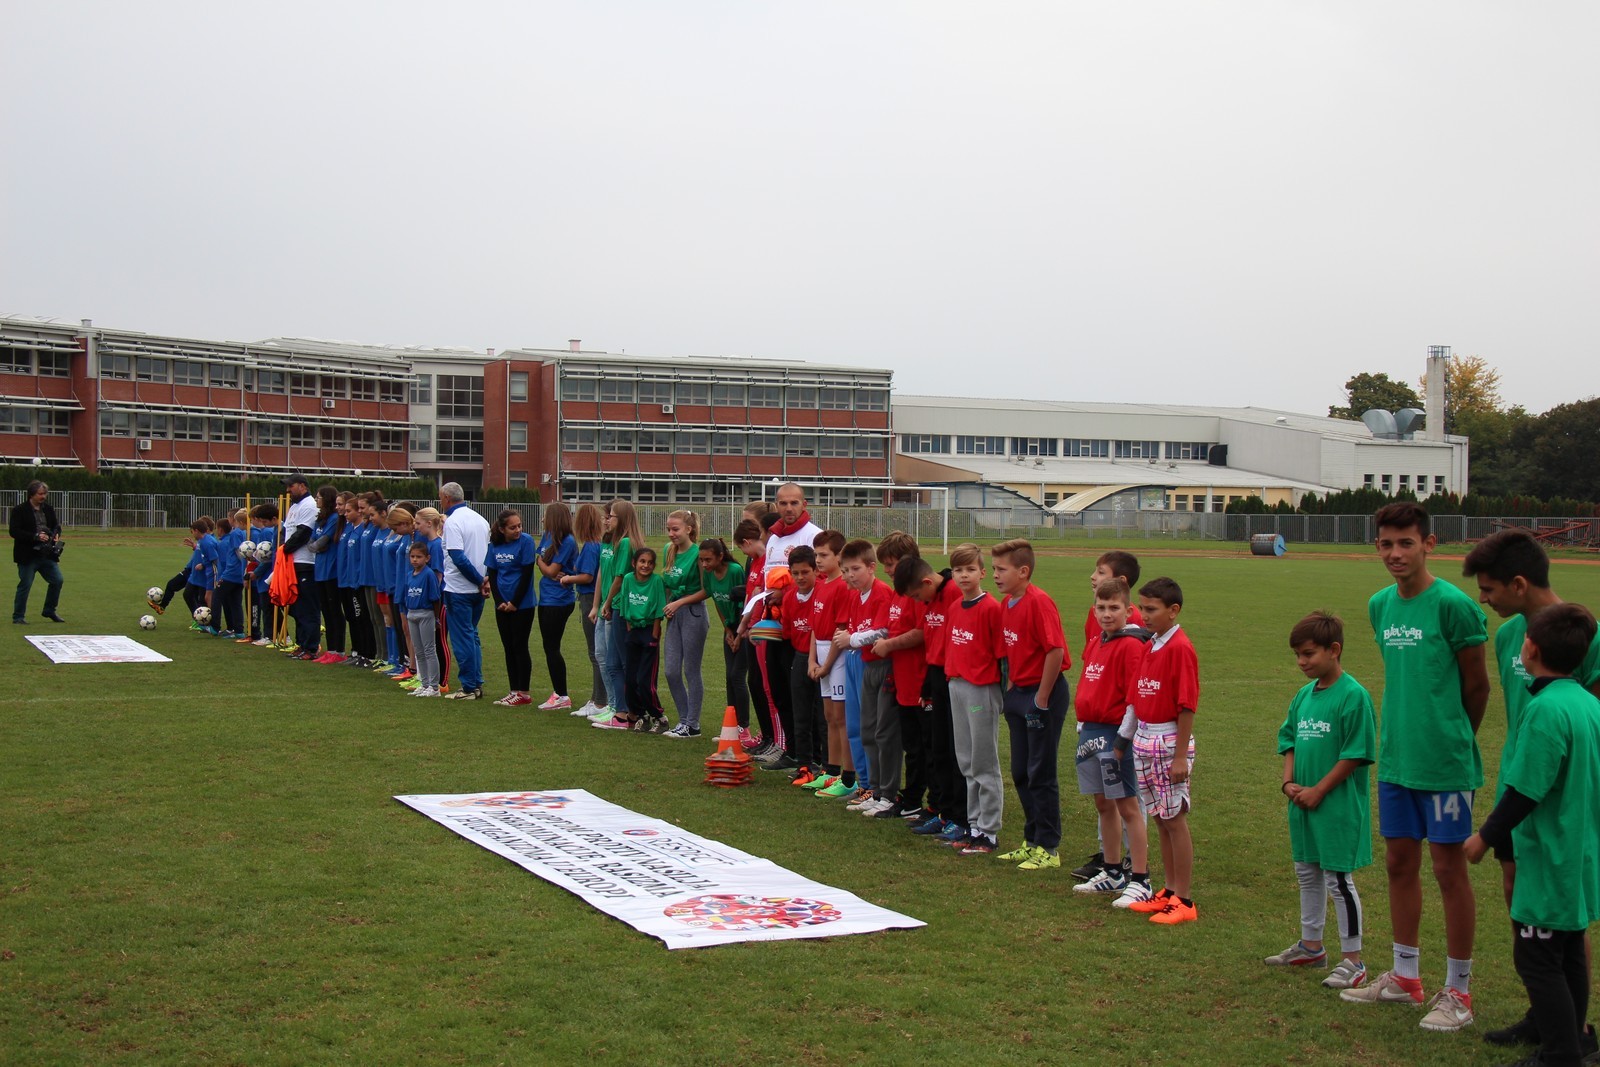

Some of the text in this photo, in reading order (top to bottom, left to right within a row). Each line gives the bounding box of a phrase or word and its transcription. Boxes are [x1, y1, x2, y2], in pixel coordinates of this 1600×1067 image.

[833, 684, 844, 696] 10
[1432, 793, 1460, 822] 14
[574, 833, 652, 857] PROTIV
[552, 867, 637, 898] EUROPI
[591, 862, 685, 898] RASIZMA
